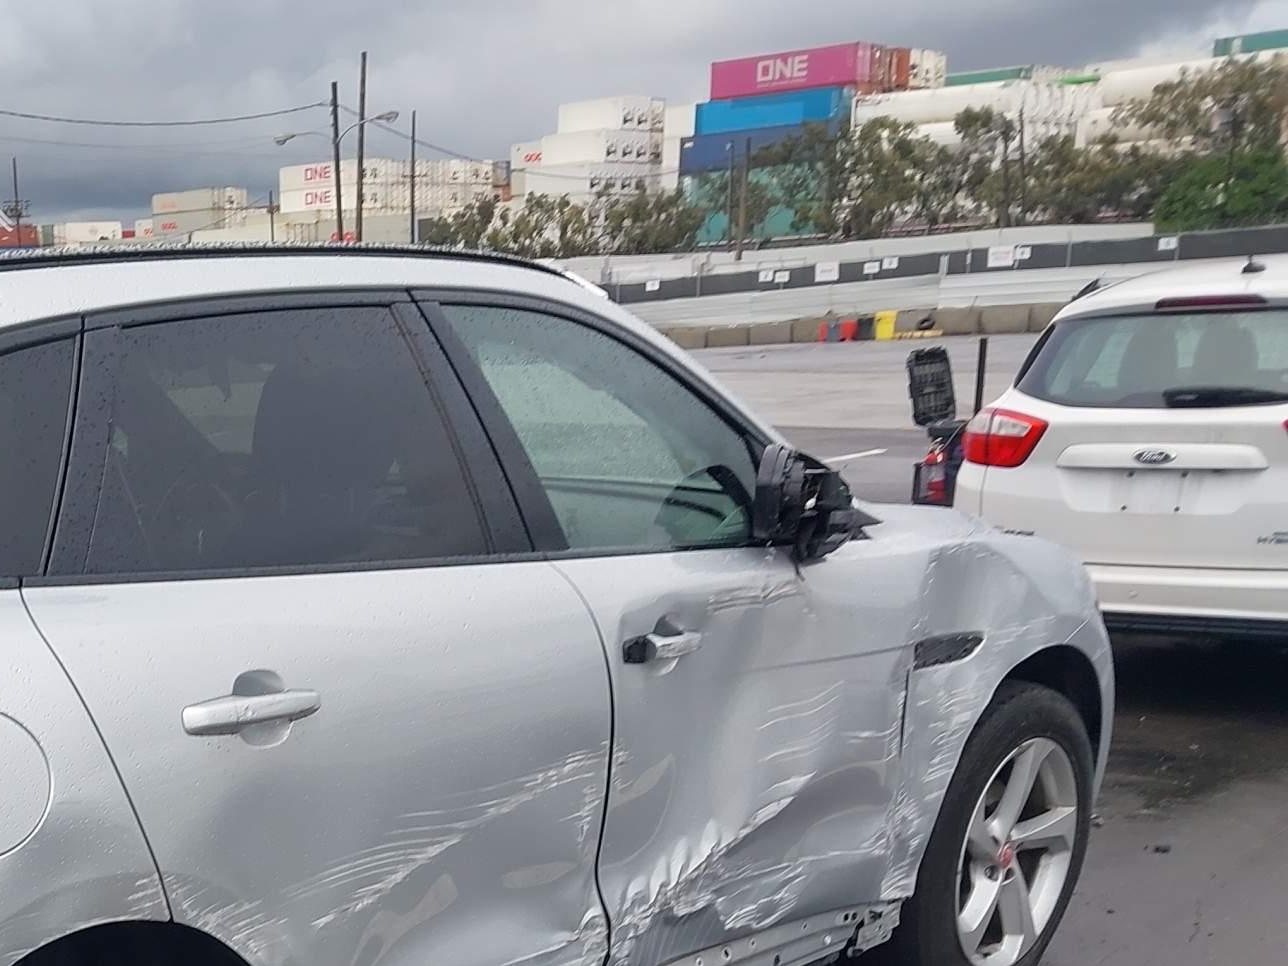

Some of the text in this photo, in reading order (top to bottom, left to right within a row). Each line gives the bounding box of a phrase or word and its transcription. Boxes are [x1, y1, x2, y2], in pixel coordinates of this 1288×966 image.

[756, 54, 809, 82] ONE
[304, 165, 331, 181] ONE
[305, 190, 332, 205] ONE
